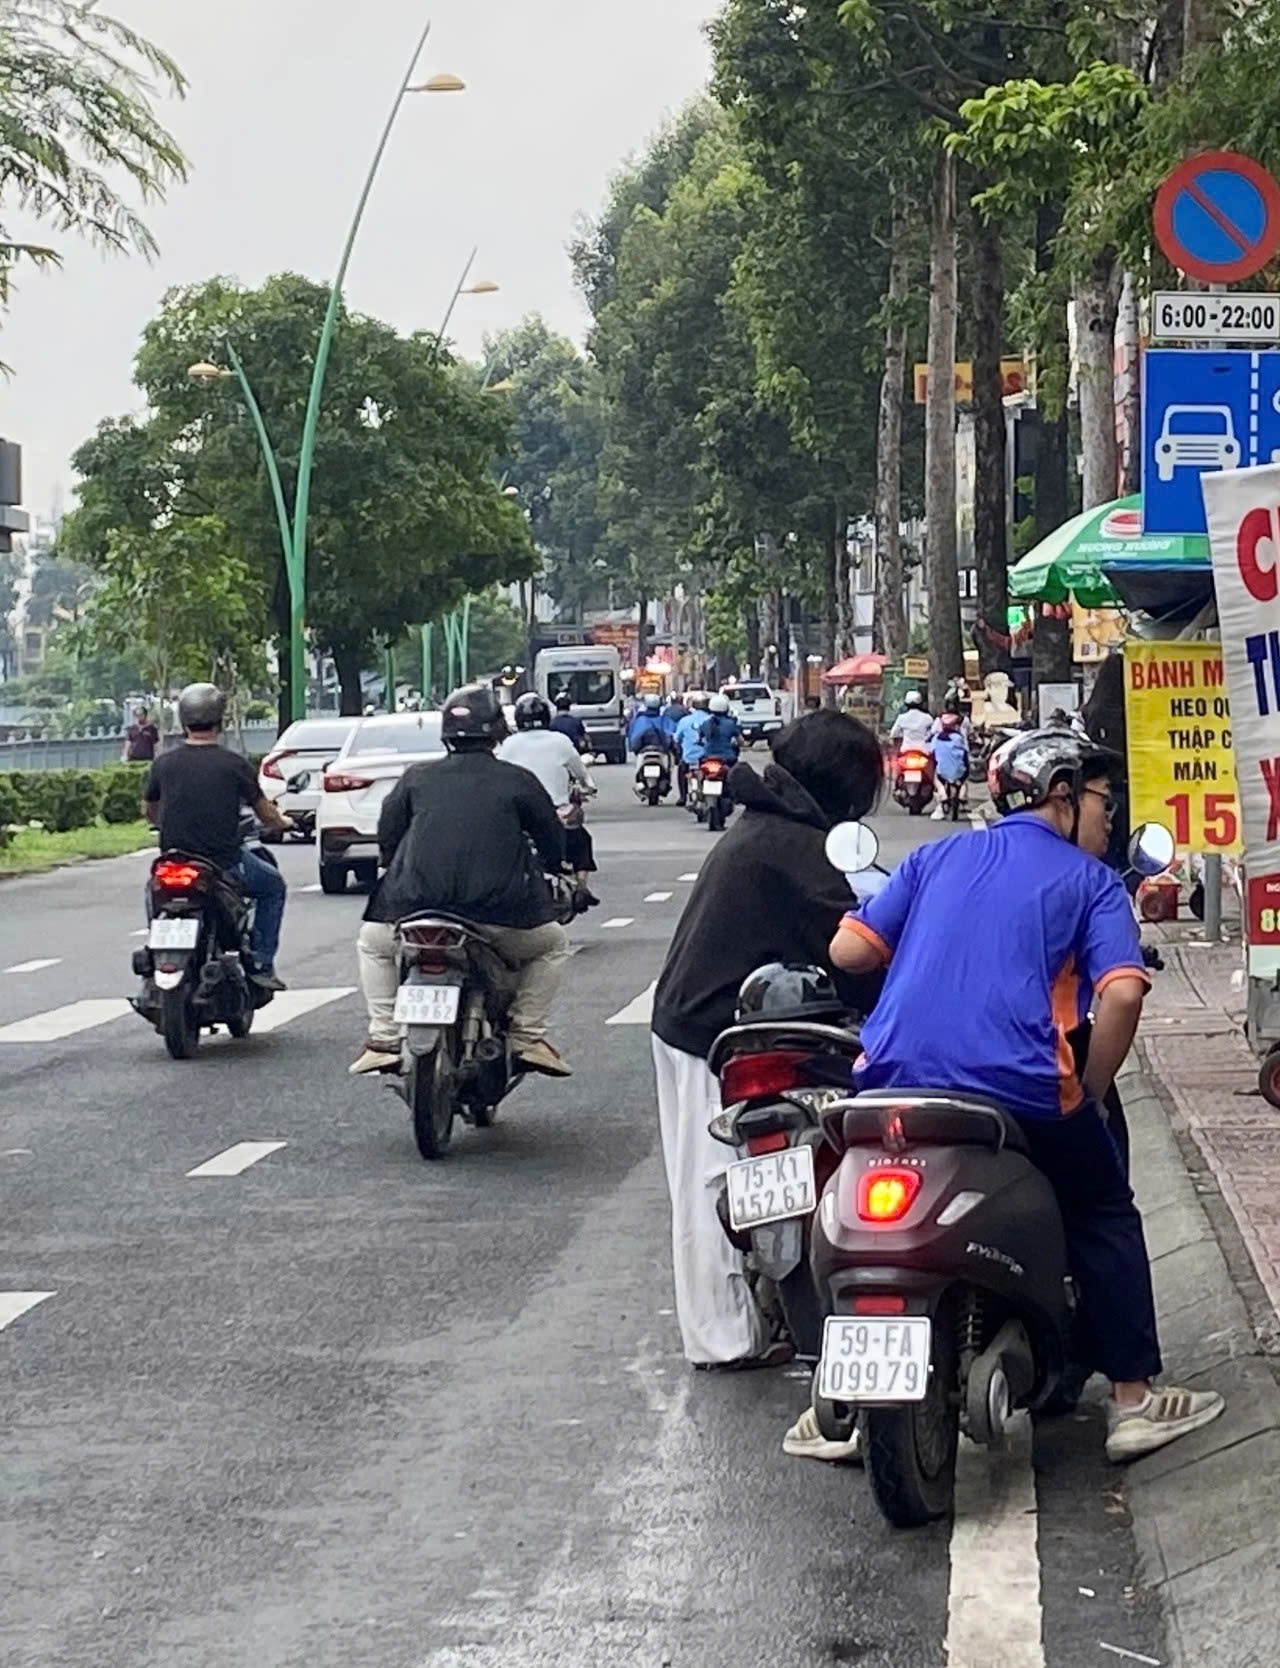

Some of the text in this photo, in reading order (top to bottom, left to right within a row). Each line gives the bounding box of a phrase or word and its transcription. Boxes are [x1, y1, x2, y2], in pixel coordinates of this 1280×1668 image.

[1131, 656, 1224, 690] BÁNH M
[1170, 697, 1207, 717] HEO
[1168, 725, 1215, 753] THẬP
[1173, 757, 1217, 786] MẶN
[1165, 792, 1237, 846] 15
[741, 1155, 797, 1192] 75-K1
[840, 1325, 912, 1357] 59-FA
